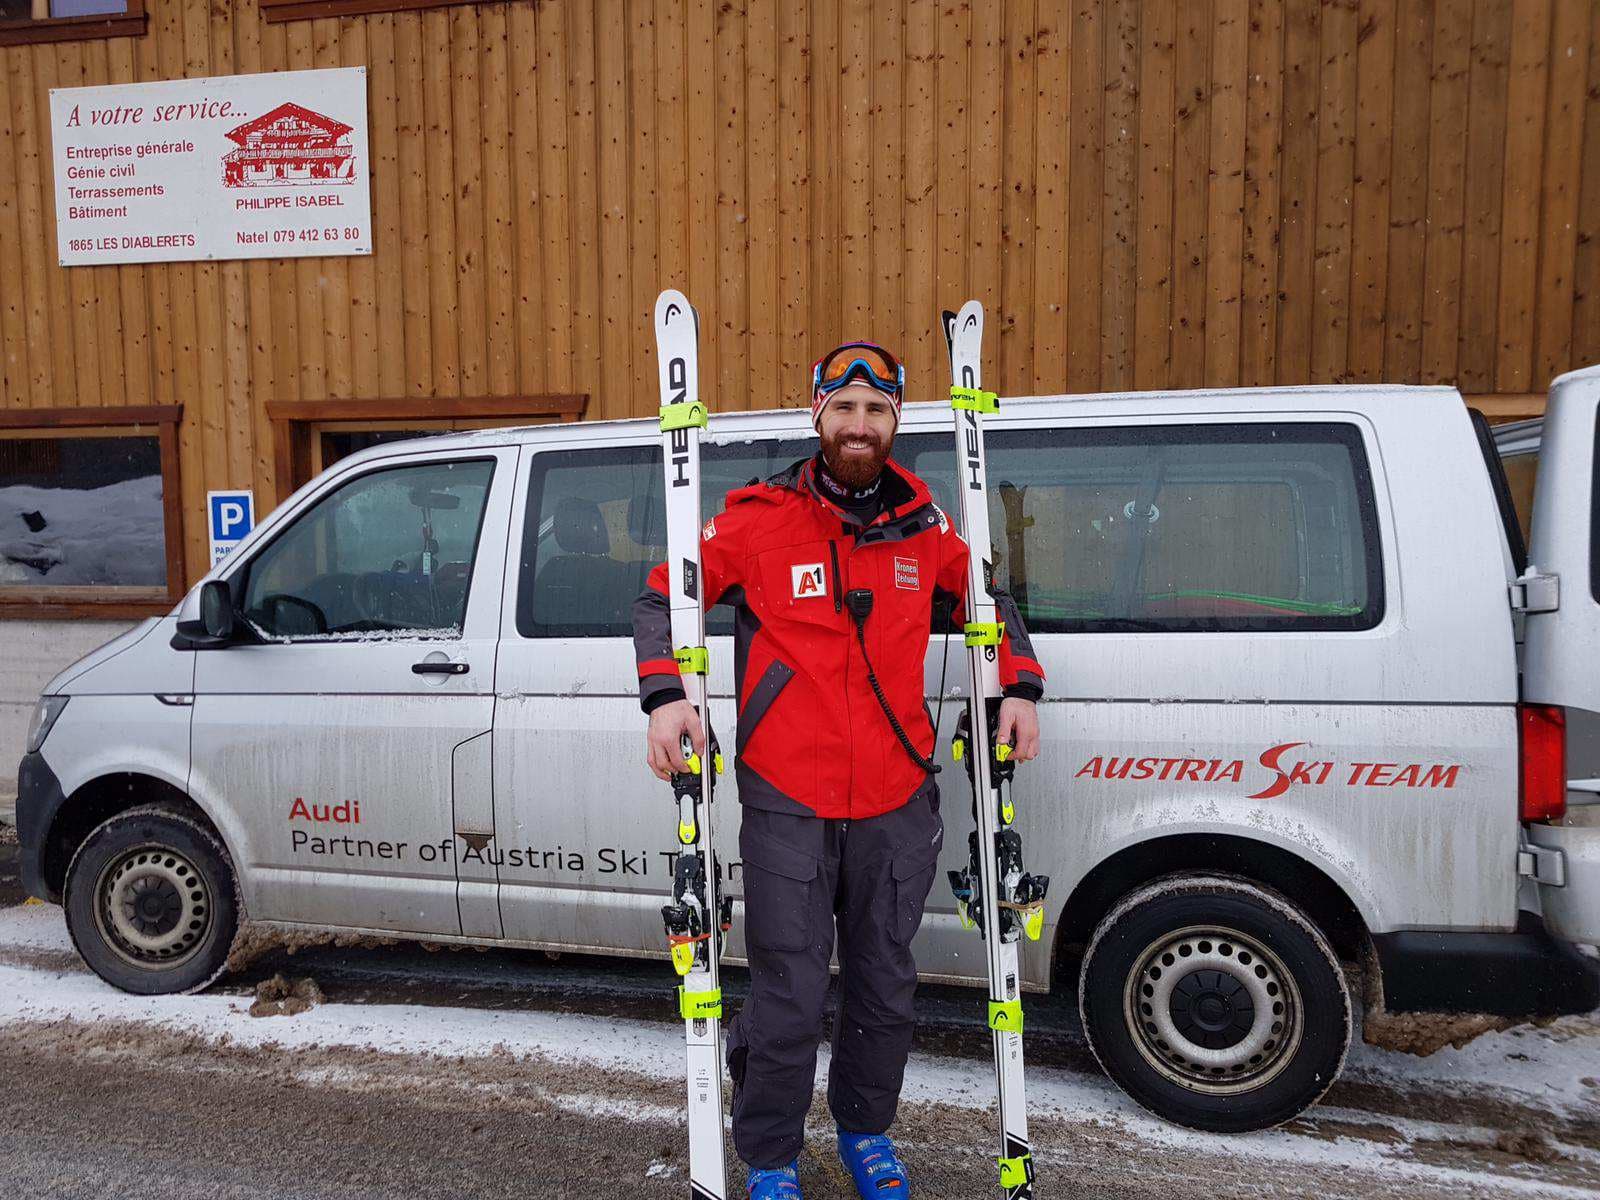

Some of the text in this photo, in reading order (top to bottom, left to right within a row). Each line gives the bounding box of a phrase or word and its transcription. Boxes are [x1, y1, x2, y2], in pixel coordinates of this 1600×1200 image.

[66, 98, 248, 127] A votre service...
[66, 140, 195, 161] Entreprise générale
[67, 163, 135, 179] Génie civil
[68, 184, 164, 199] Terrassements
[235, 194, 344, 210] PHILIPPE ISABEL
[69, 205, 127, 219] Bâtiment
[68, 234, 195, 251] 1865 LES DIABLERETS
[236, 227, 360, 243] Natel 079 412 63 80
[220, 502, 244, 536] P
[798, 567, 823, 595] A1
[1074, 742, 1462, 799] AUSTRIA SKI TEAM
[288, 797, 360, 824] Audi
[292, 830, 407, 859] Partner
[419, 840, 453, 862] of
[462, 845, 584, 872] Austria
[598, 848, 648, 876] Ski
[696, 999, 722, 1009] HEA
